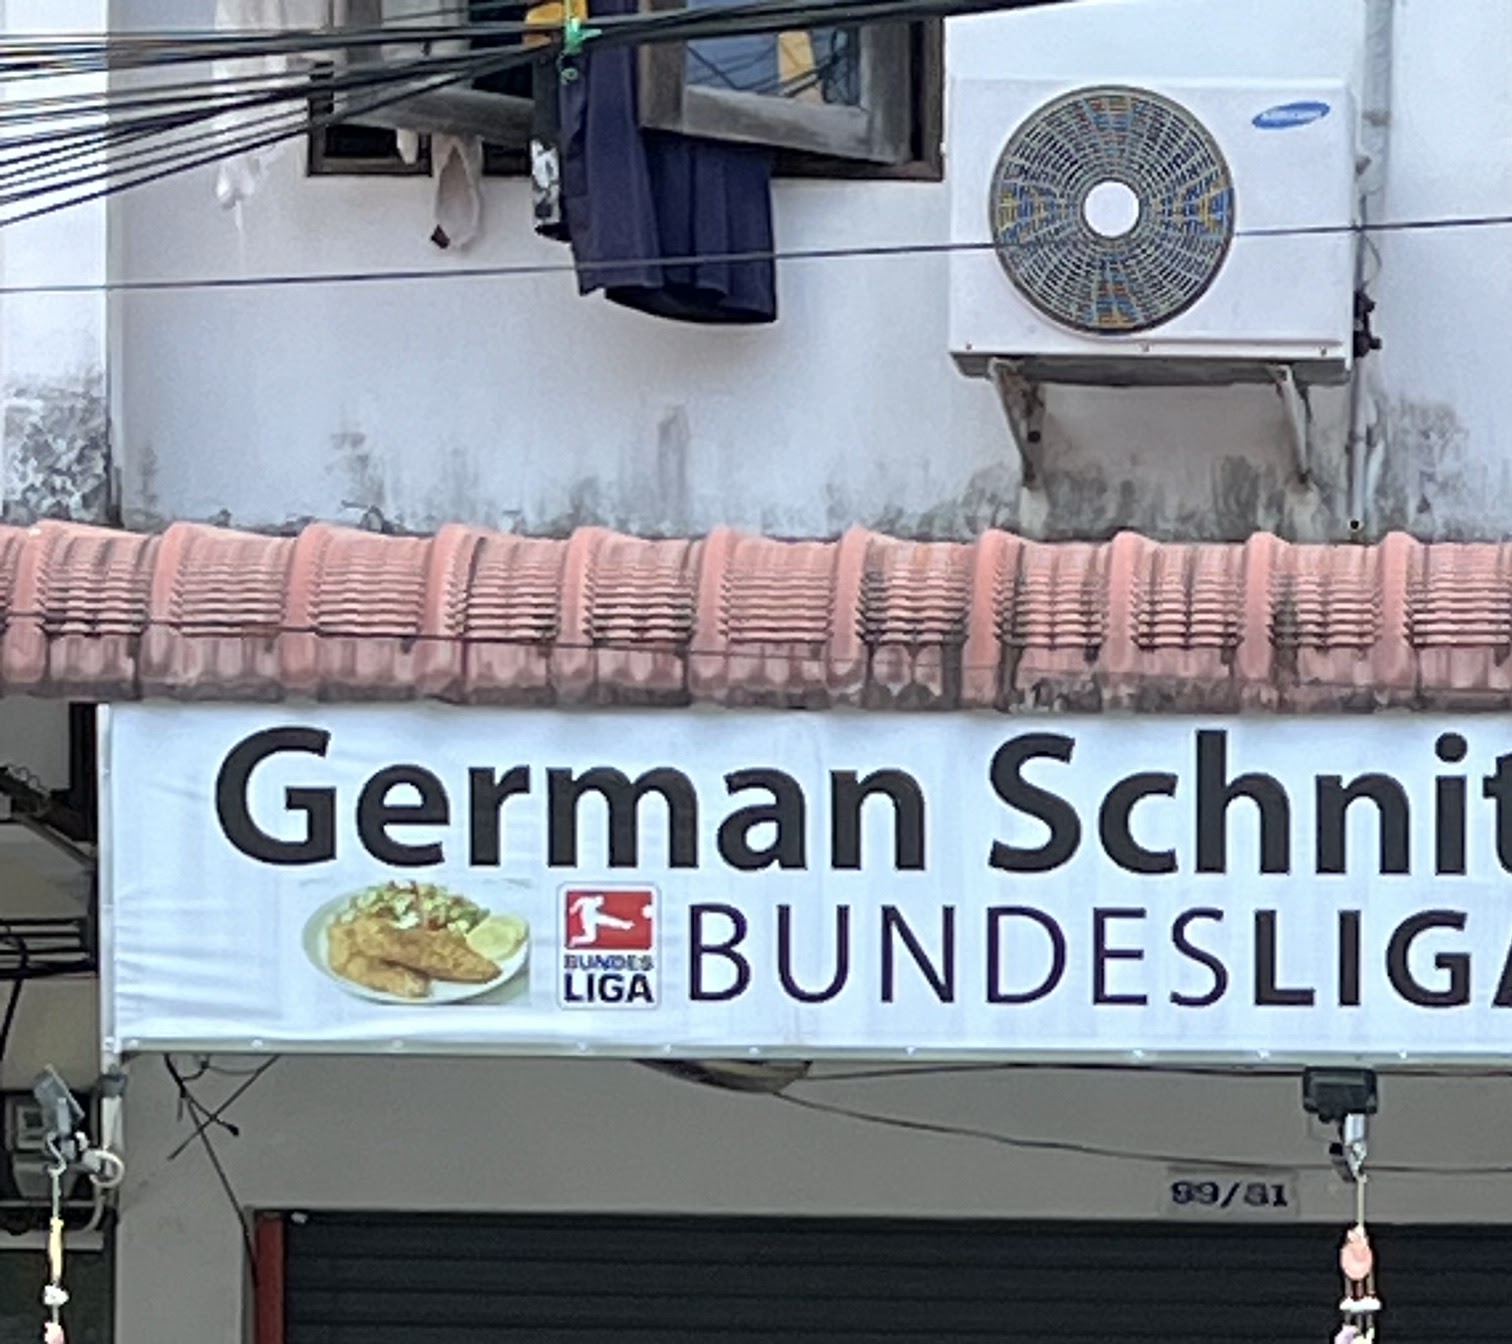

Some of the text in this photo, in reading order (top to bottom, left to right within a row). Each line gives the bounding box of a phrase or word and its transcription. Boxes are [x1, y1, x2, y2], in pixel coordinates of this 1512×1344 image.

[214, 725, 927, 872] German
[563, 954, 655, 971] BUNDES
[563, 972, 655, 1003] LIGA
